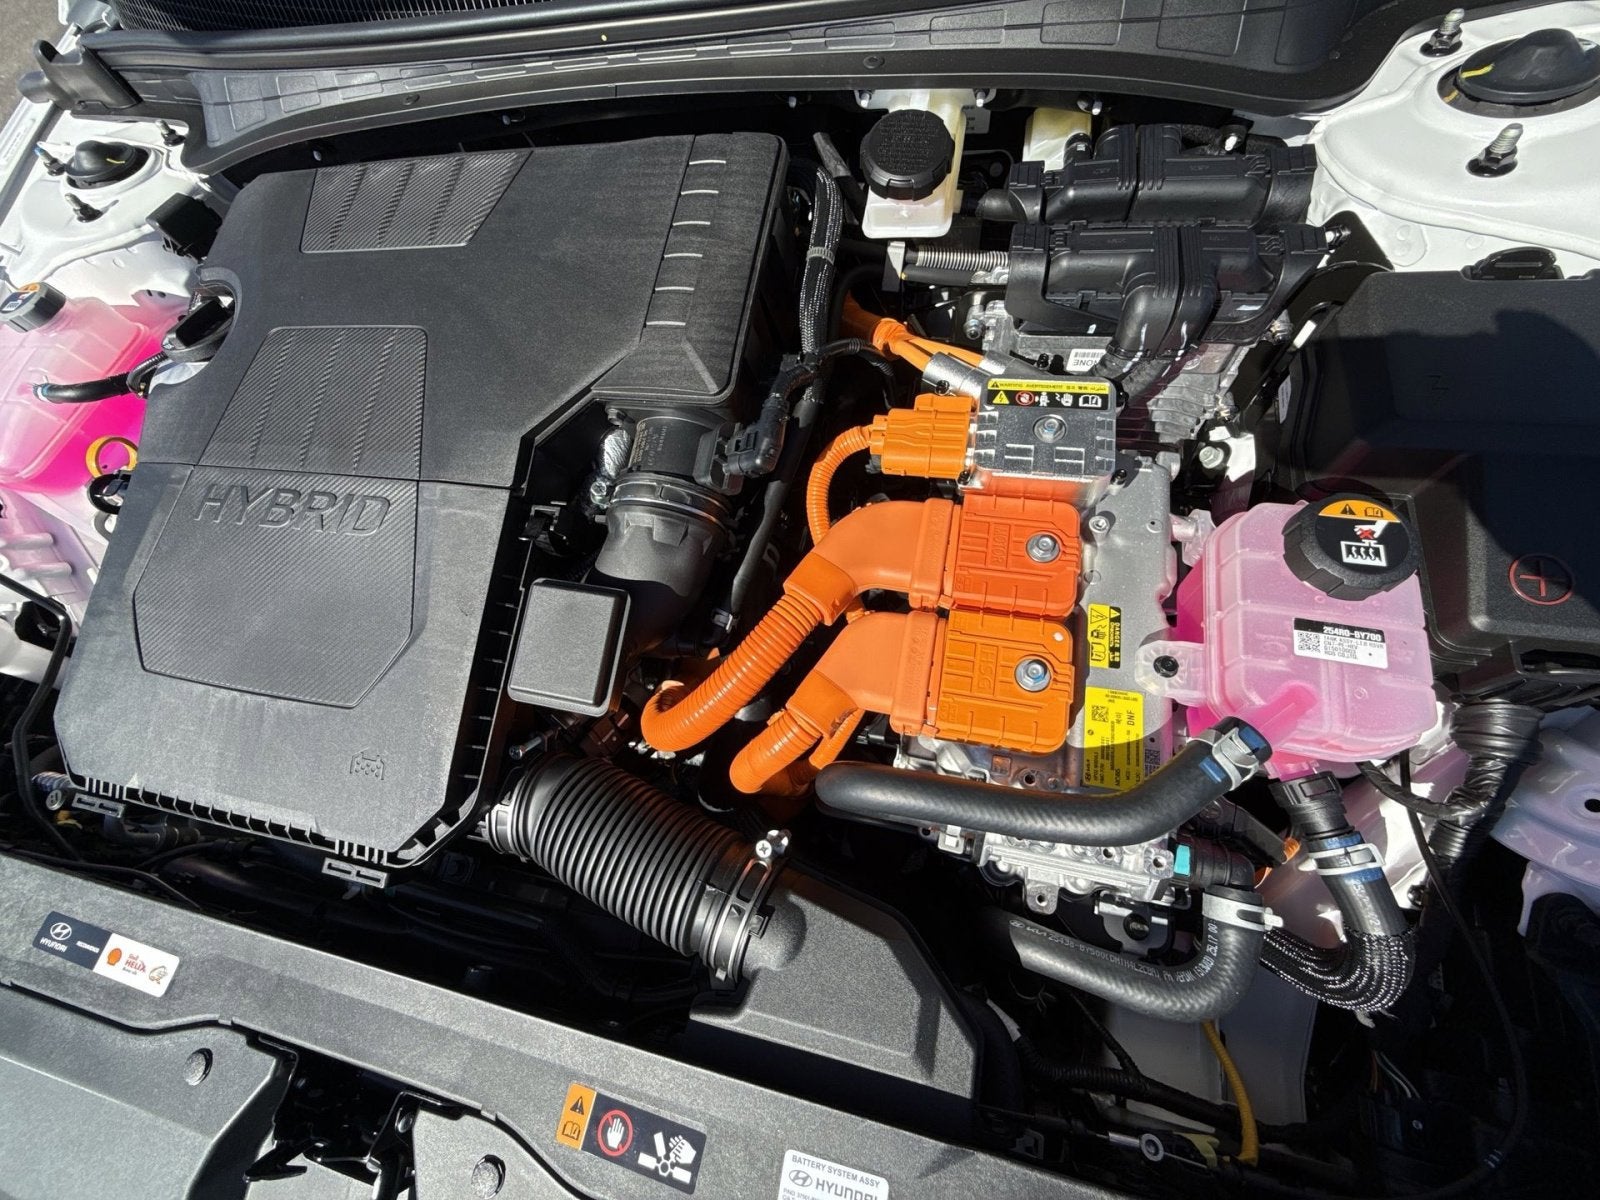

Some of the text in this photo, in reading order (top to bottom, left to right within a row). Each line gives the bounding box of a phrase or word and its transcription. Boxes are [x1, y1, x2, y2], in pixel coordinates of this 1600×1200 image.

[194, 484, 391, 536] HYBRID
[993, 526, 1007, 565] MOTOR
[978, 648, 994, 691] HSG
[1127, 709, 1135, 726] DNF
[39, 937, 68, 953] HYUNDAI
[124, 960, 147, 974] HELIX
[792, 1154, 881, 1188] BATTERY SYSTEM ASSY
